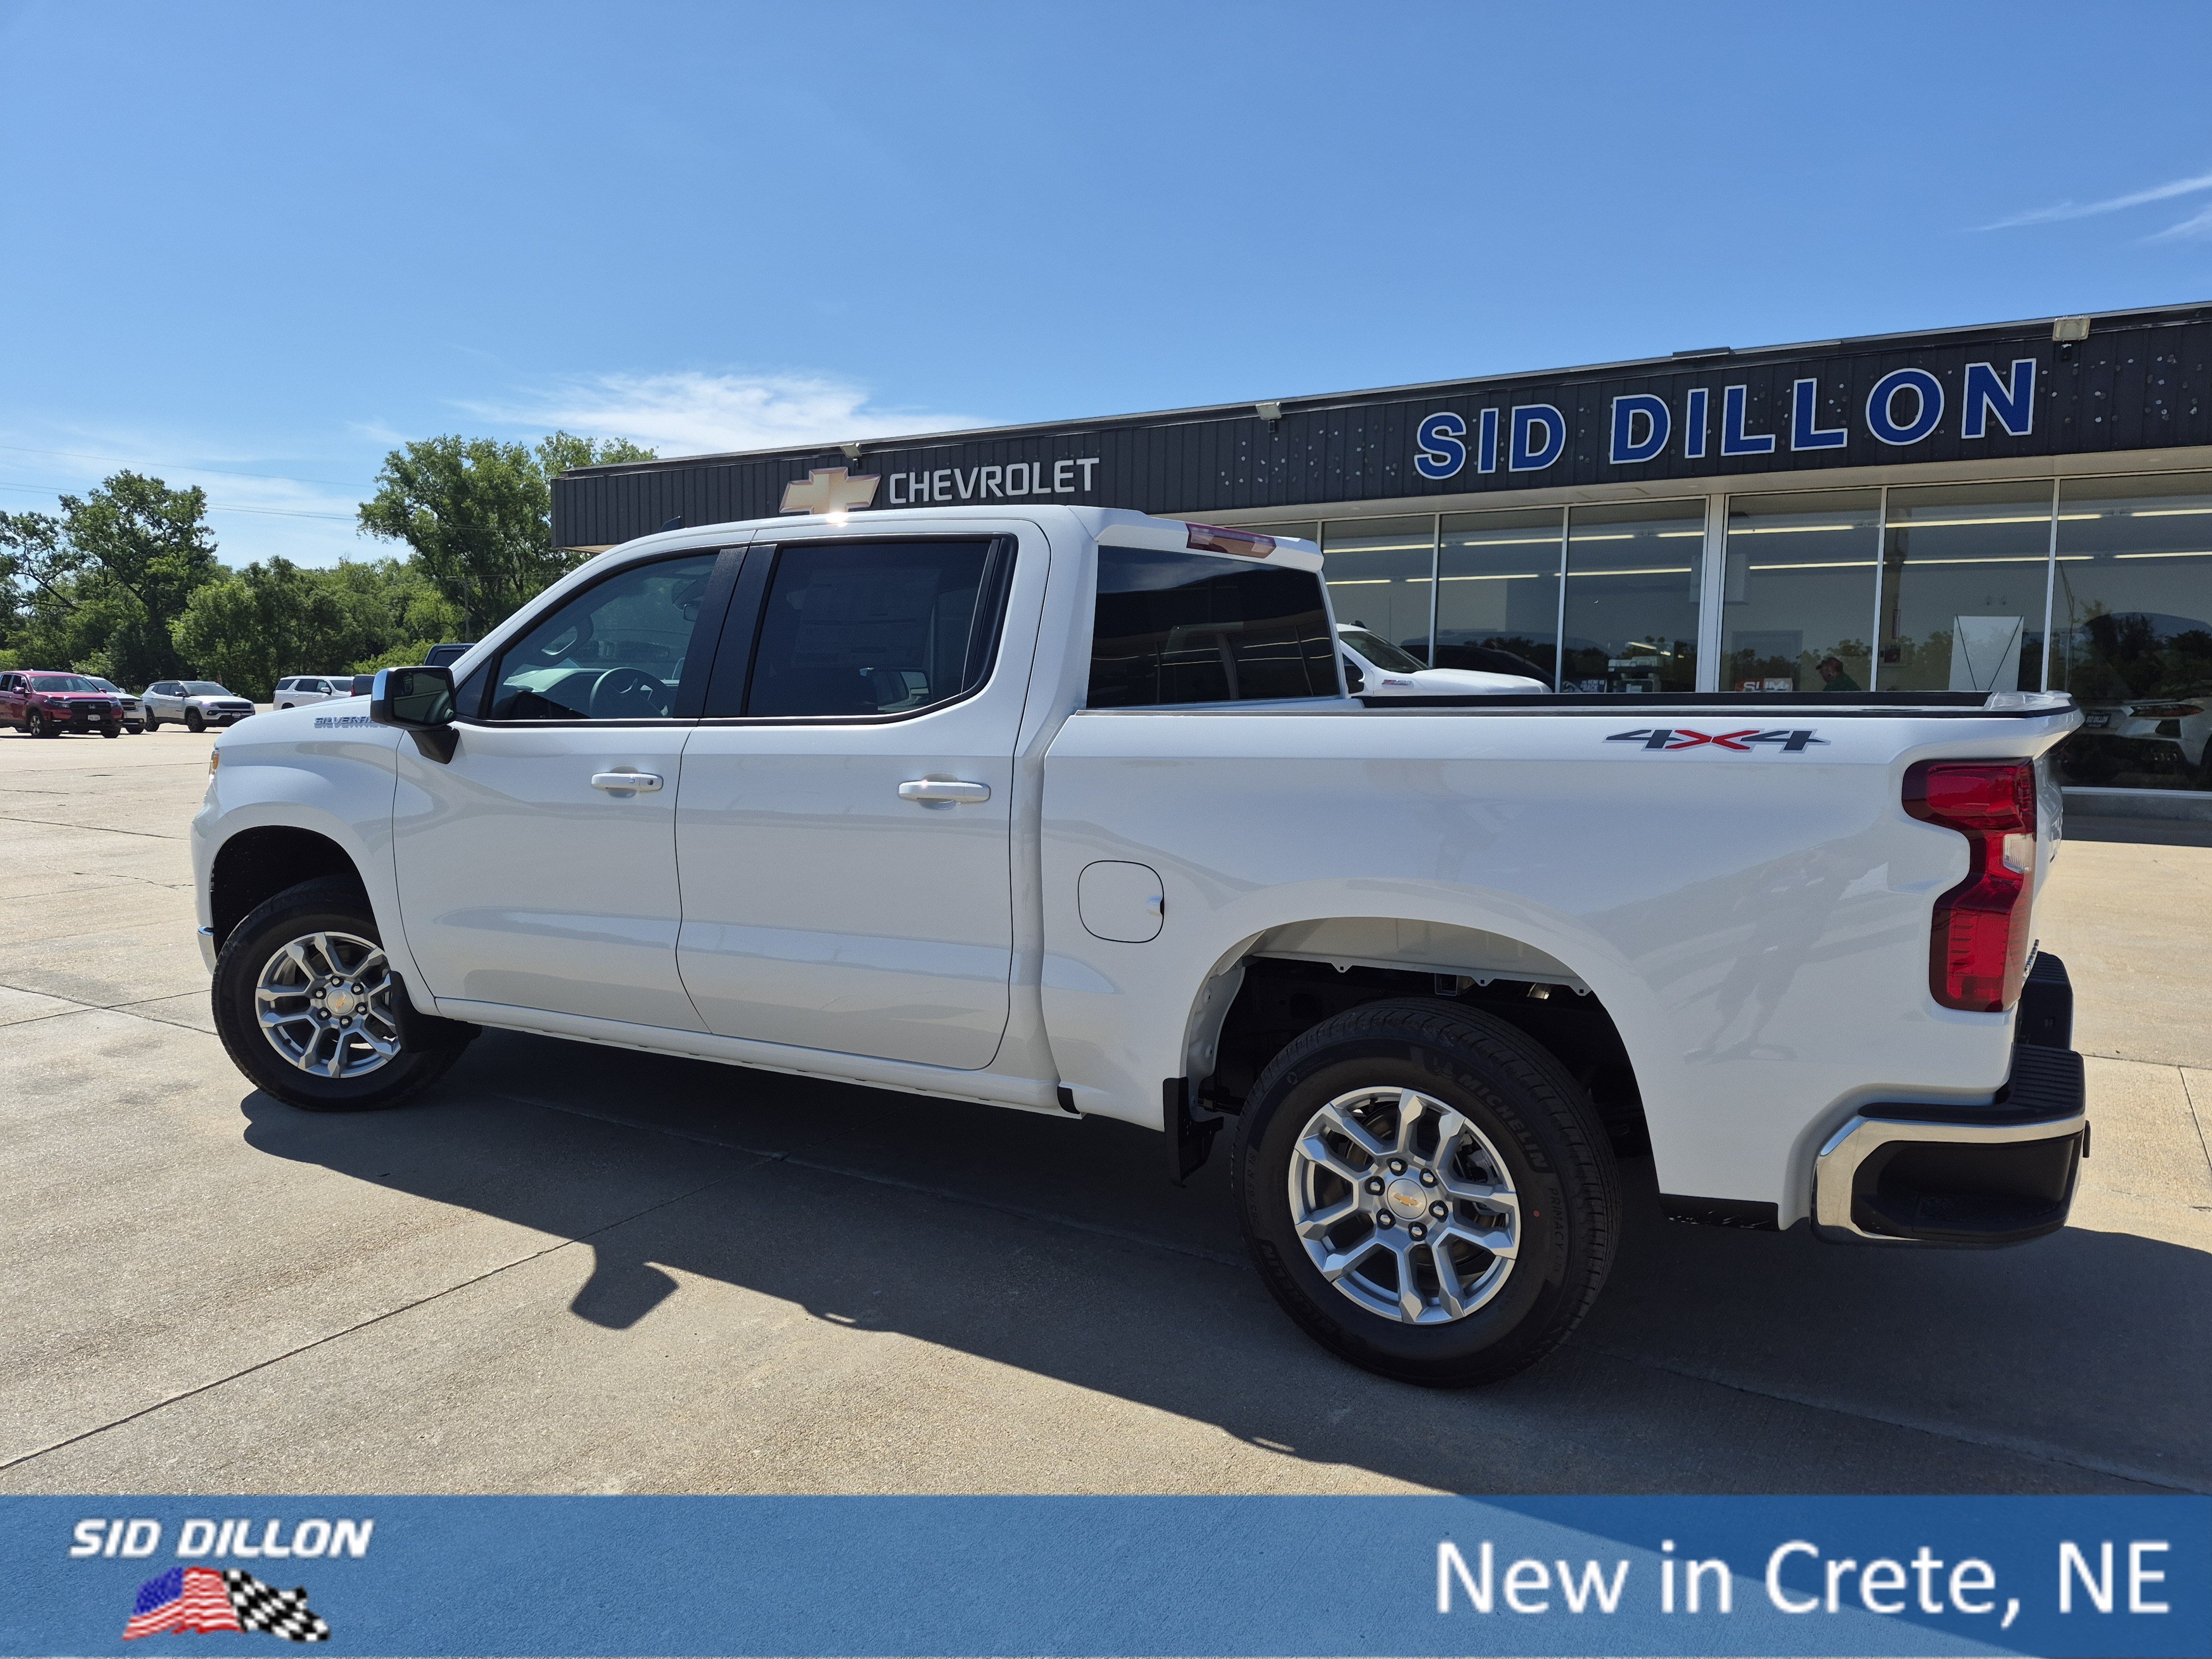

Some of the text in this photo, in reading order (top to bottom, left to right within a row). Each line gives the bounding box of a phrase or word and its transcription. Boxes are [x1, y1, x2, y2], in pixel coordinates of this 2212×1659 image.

[1413, 358, 2037, 480] SID DILLON
[889, 457, 1100, 504] CHEVROLET
[1458, 1072, 1549, 1168] MICHELIN
[1548, 1187, 1564, 1251] PRIMACY
